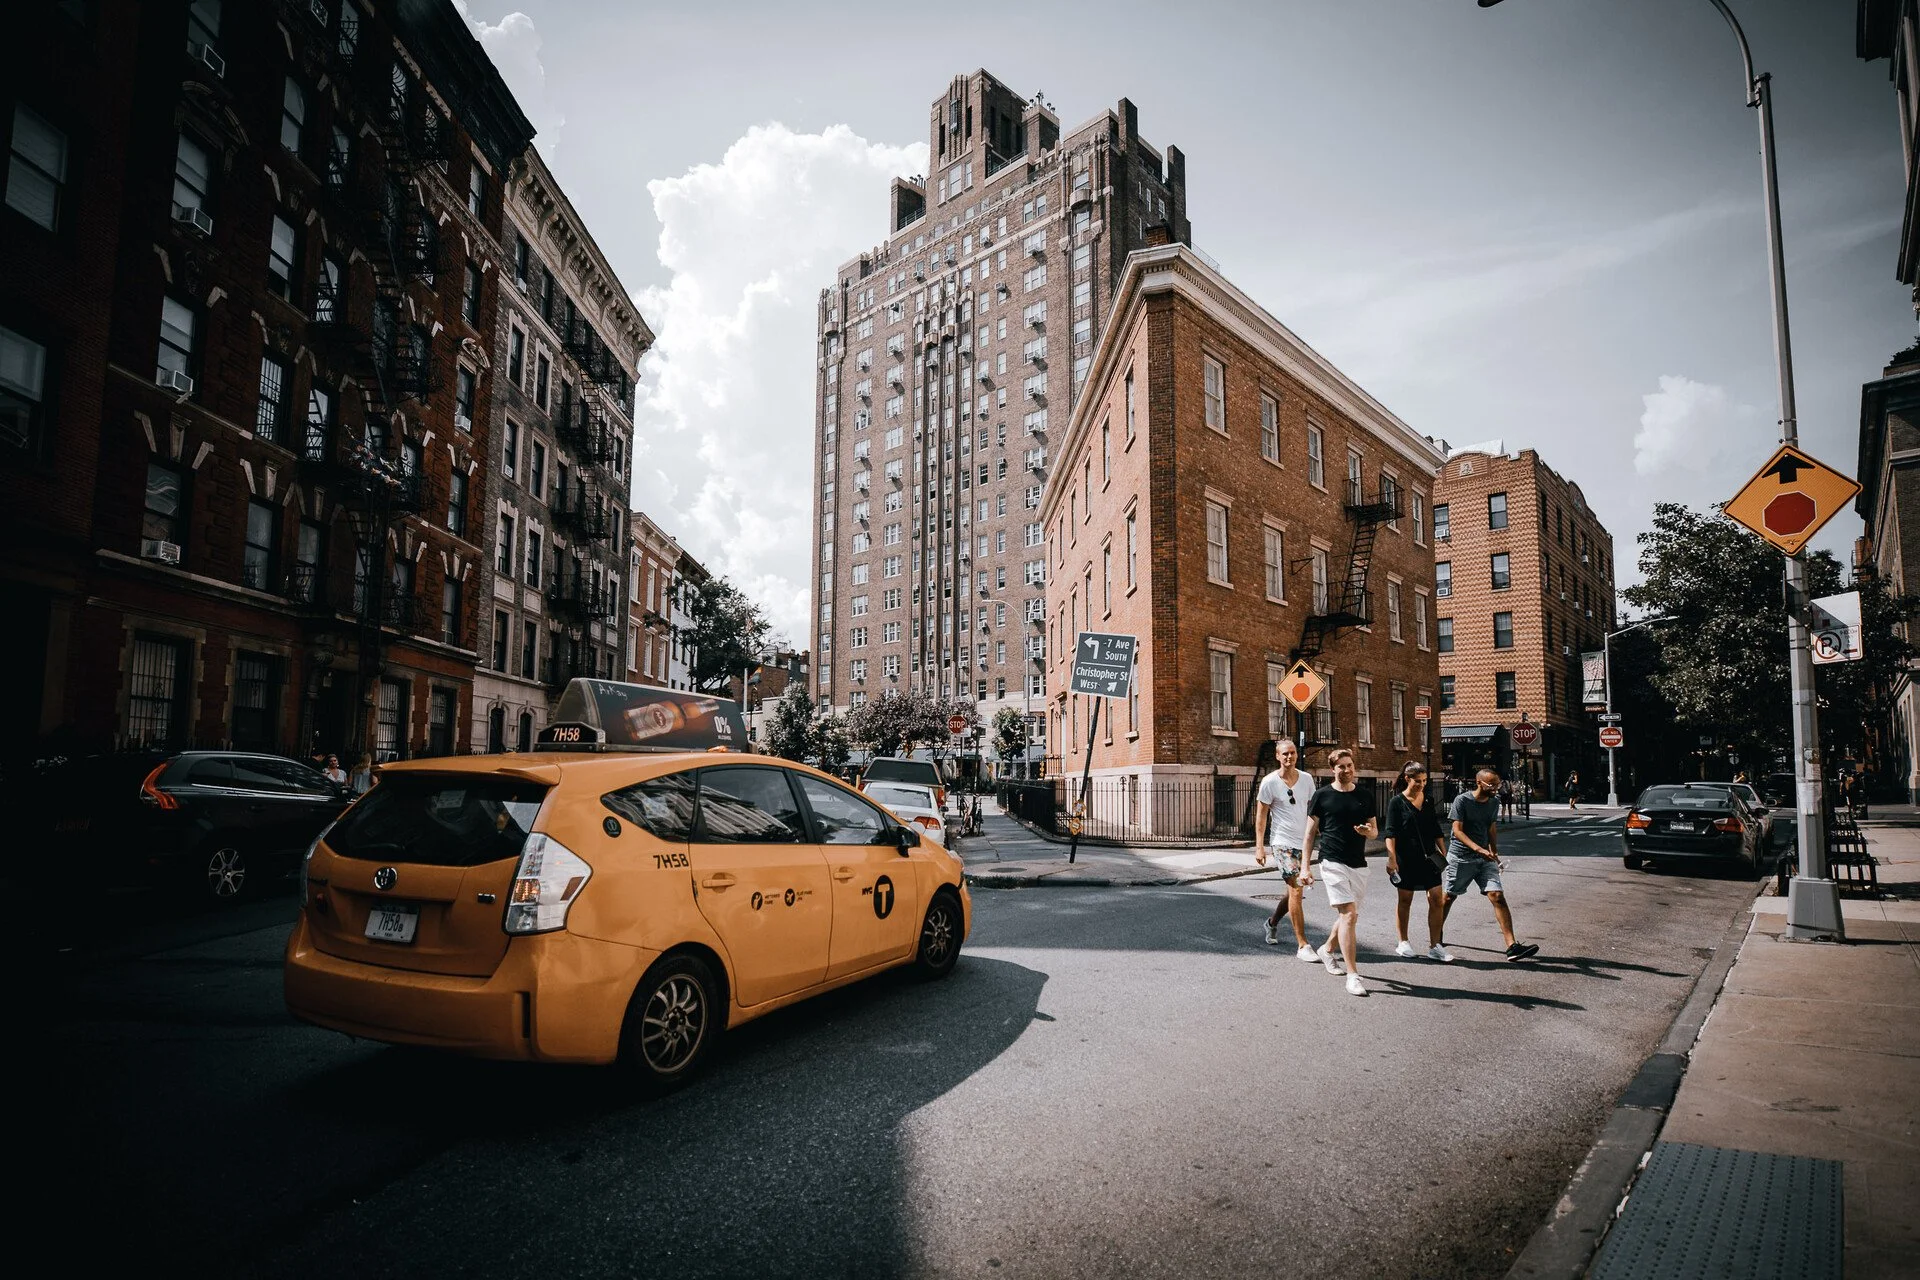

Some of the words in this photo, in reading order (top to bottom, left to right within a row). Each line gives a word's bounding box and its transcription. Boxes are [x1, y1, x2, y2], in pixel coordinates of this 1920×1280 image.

[1115, 640, 1130, 650] Ave
[1105, 651, 1127, 662] SOUTH
[1076, 666, 1118, 680] Christopher
[1119, 671, 1129, 681] St
[1080, 679, 1098, 689] WEST
[713, 715, 732, 735] 0%
[949, 720, 966, 729] STOP
[553, 727, 580, 742] 7H58
[1514, 729, 1536, 738] STOP
[653, 853, 689, 869] 7H58
